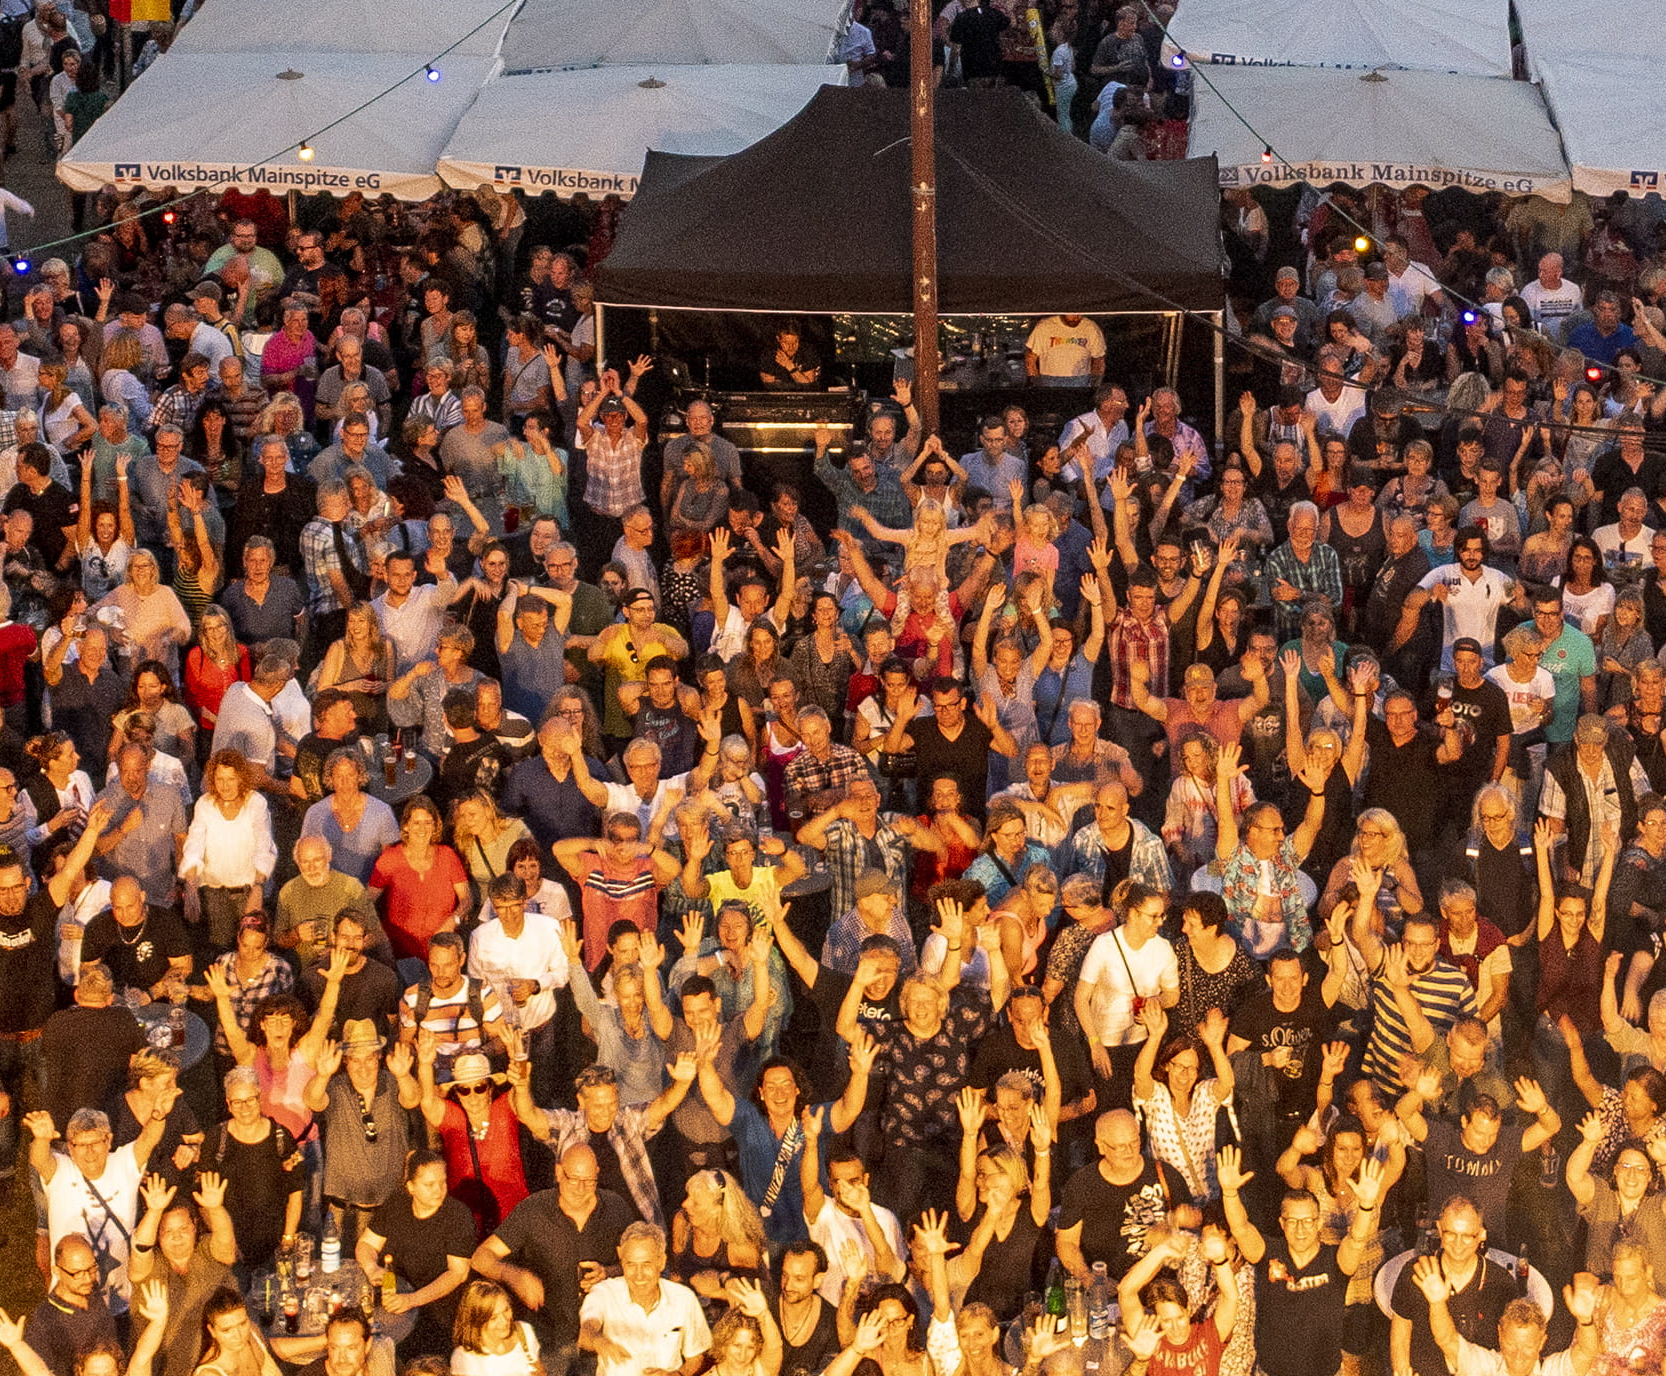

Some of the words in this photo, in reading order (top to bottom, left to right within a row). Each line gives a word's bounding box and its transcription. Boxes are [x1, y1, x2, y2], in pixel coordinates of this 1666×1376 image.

[147, 164, 241, 183] Volksbank
[248, 166, 349, 189] Mainspitze
[354, 173, 380, 189] eG
[528, 169, 624, 191] Volksbank
[1245, 162, 1365, 183] Volksbank
[1371, 164, 1497, 191] Mainspitze
[1503, 178, 1533, 194] eG
[1261, 1026, 1313, 1048] s.Oliver
